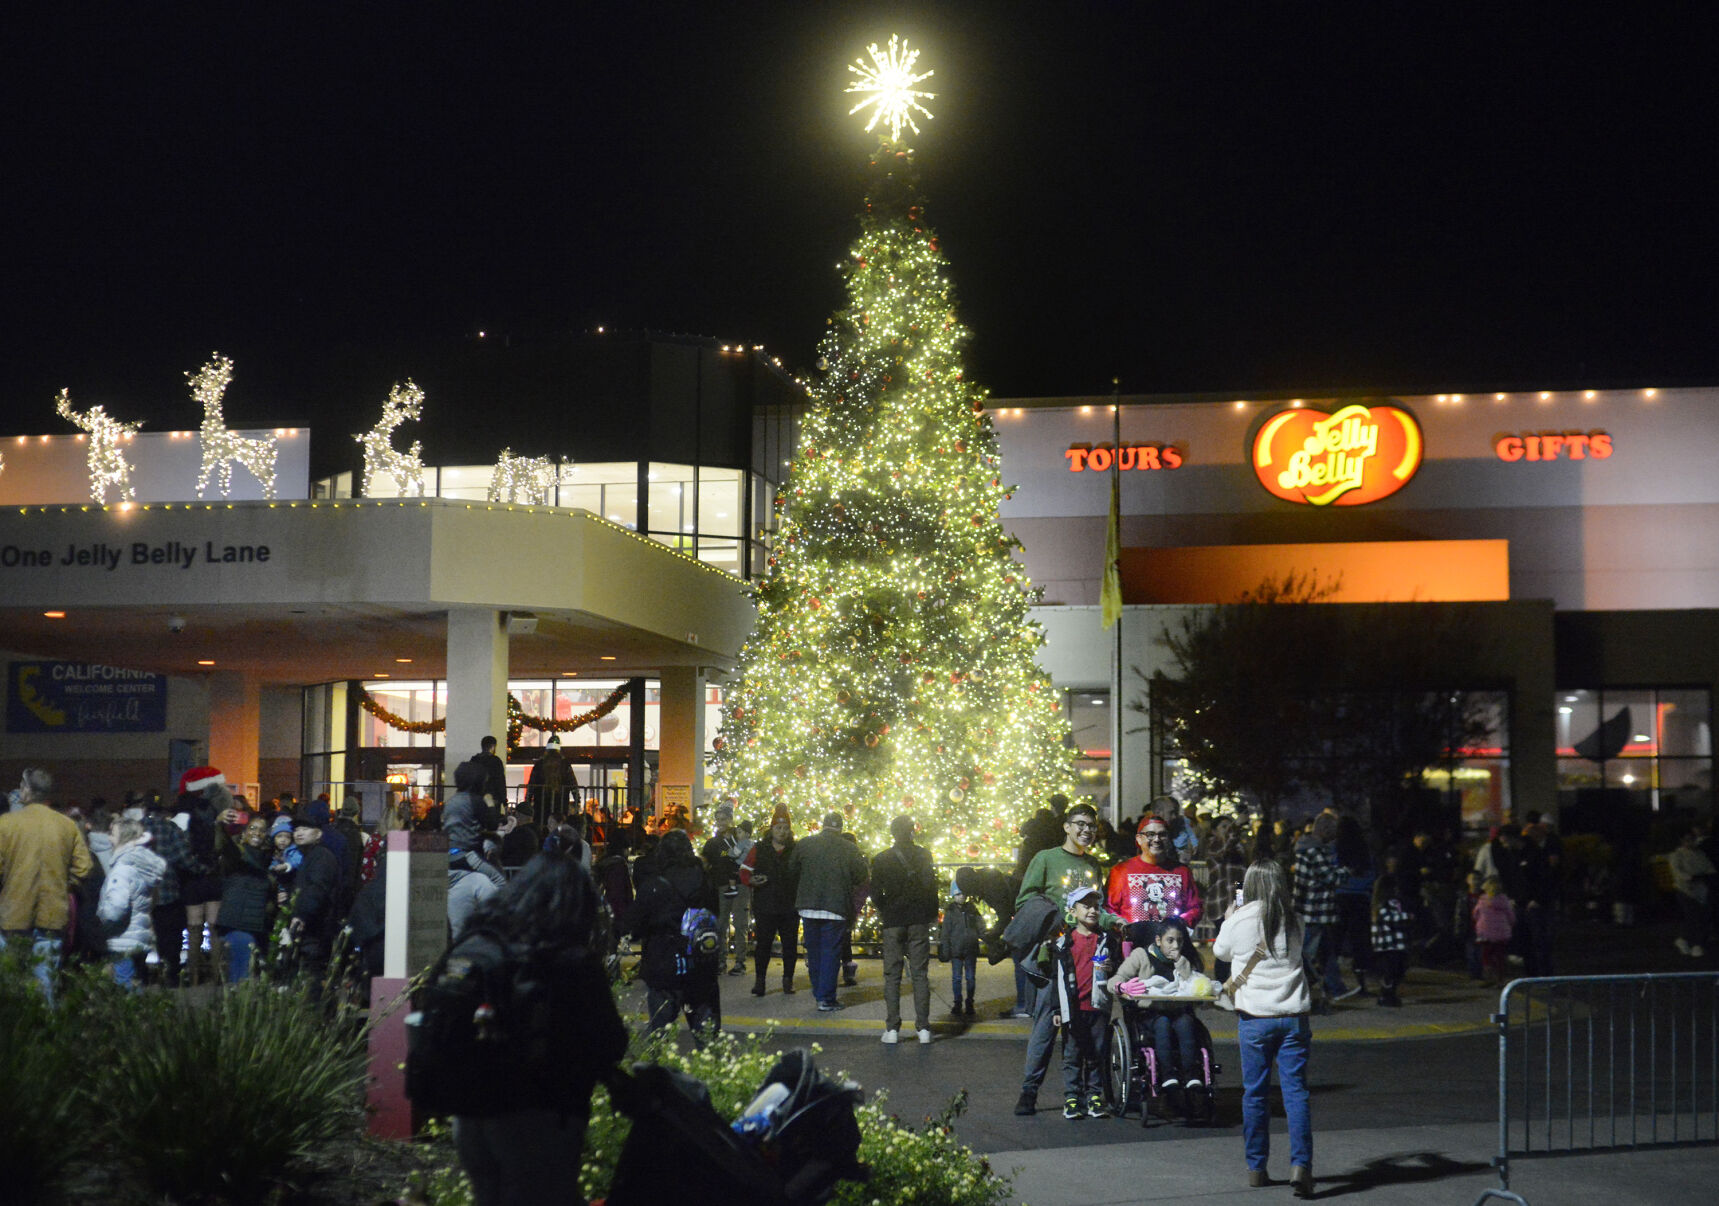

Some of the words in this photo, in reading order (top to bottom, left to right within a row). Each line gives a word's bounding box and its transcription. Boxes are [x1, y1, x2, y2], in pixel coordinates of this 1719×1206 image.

[1304, 405, 1378, 458] Jelly
[1065, 446, 1182, 472] TOURS
[1496, 434, 1613, 462] GIFTS
[1278, 450, 1366, 505] Belly
[1, 545, 52, 567] One
[61, 544, 121, 571] Jelly
[131, 542, 196, 569] Belly
[206, 541, 271, 563] Lane
[65, 684, 113, 694] WELCOME
[116, 684, 156, 693] CENTER
